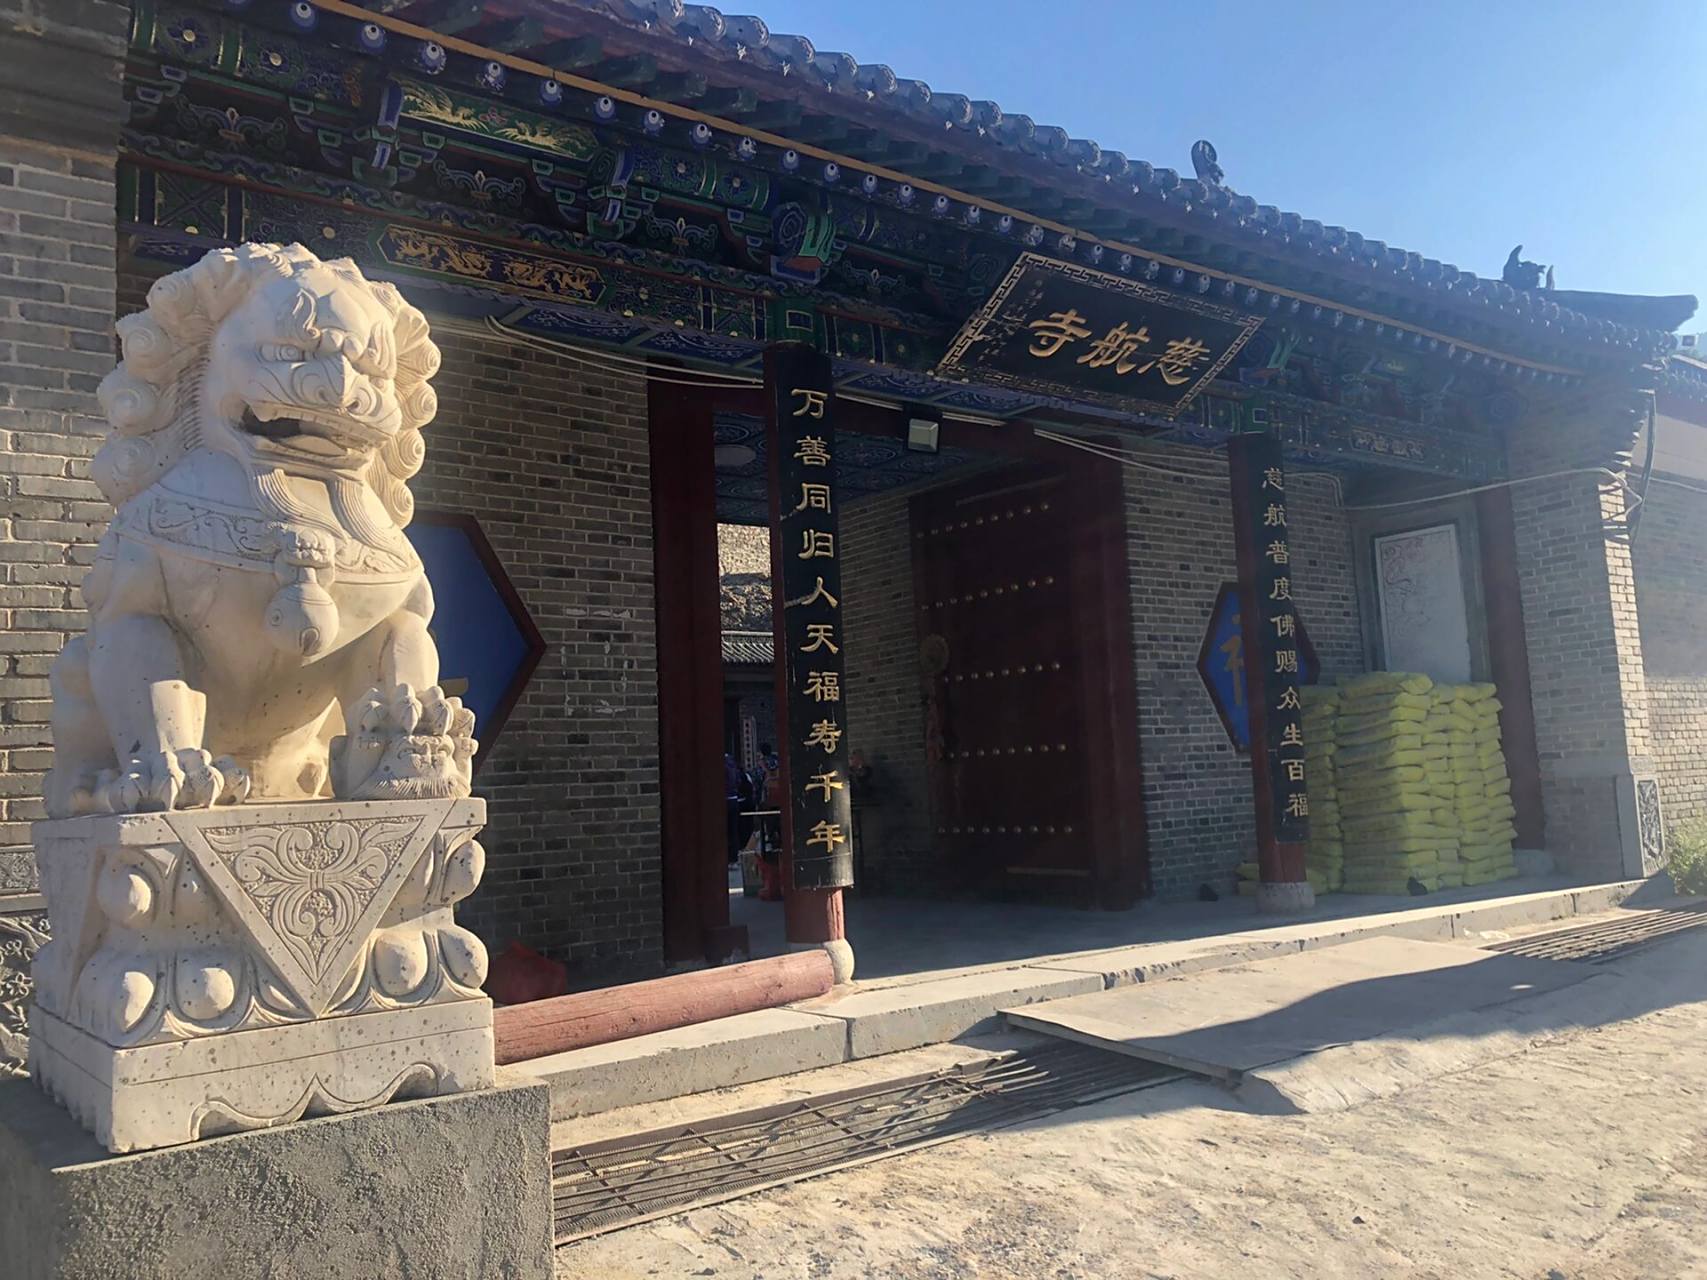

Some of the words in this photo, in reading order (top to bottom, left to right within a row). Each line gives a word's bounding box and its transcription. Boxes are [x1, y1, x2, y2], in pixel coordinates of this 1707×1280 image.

[1028, 308, 1211, 386] 慈航寺
[790, 388, 846, 853] 万善同归人天福寿千年
[1262, 467, 1309, 817] 慈航普度佛赐众生百福
